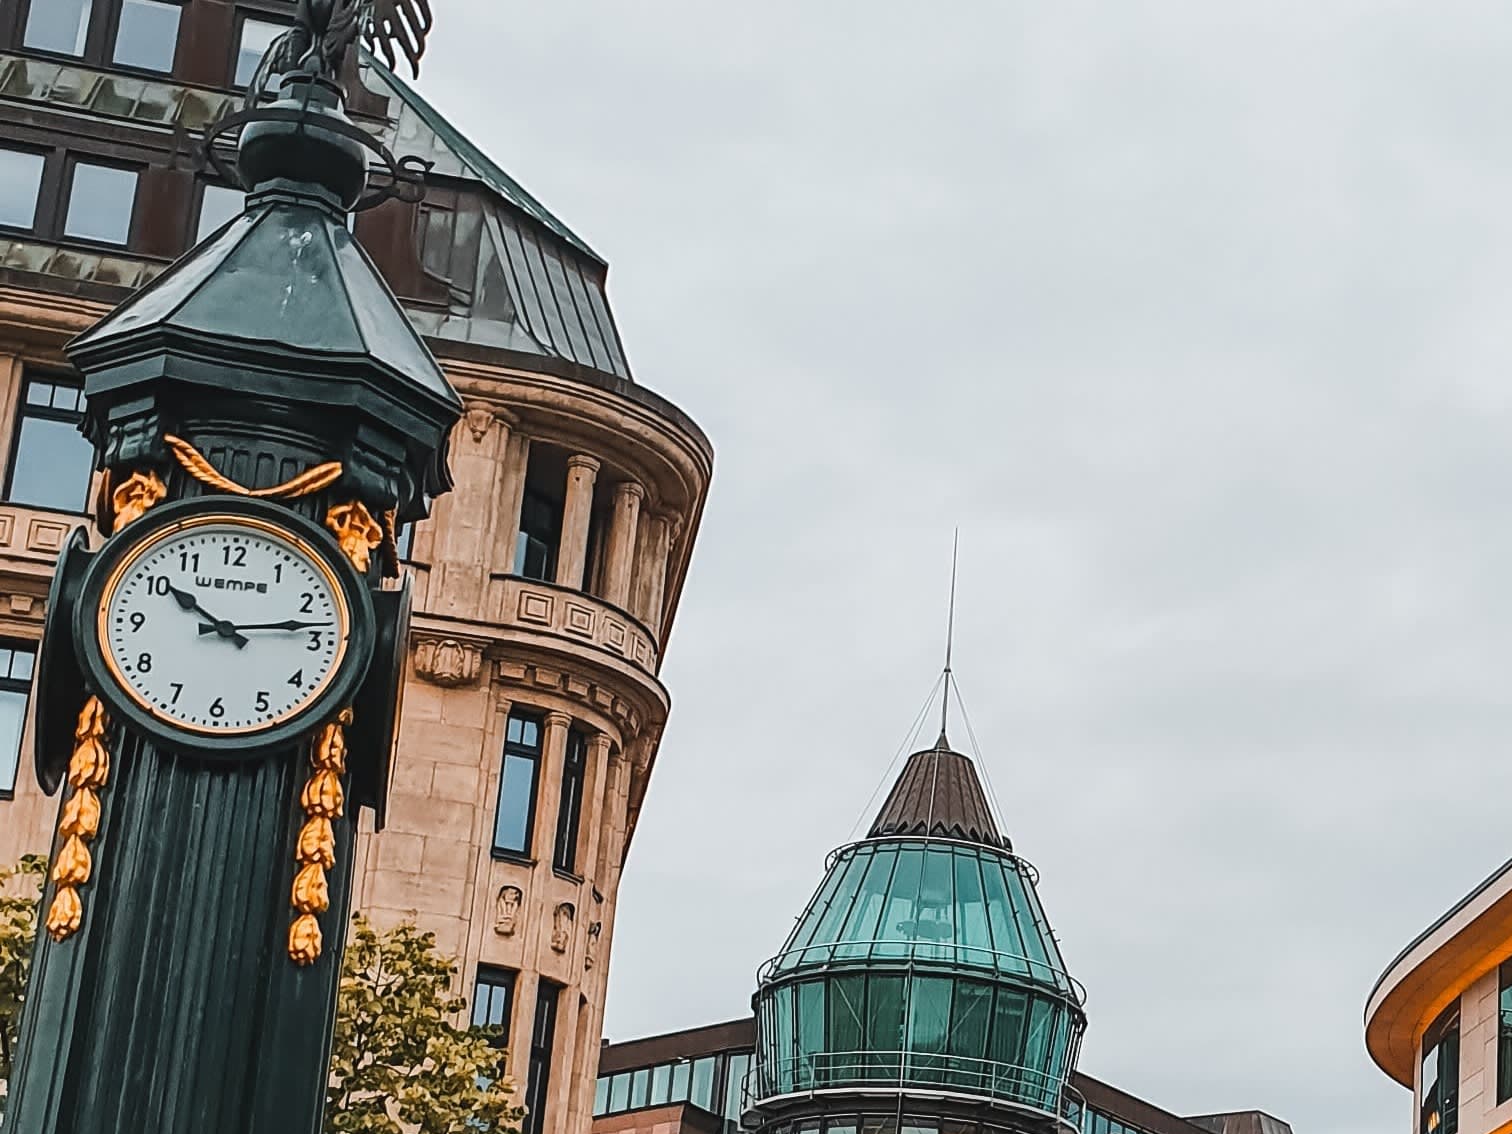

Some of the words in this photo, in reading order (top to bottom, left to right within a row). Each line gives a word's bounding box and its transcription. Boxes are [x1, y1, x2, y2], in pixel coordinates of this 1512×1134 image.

[179, 551, 200, 573] 11
[222, 545, 247, 567] 12
[273, 563, 283, 583] 1
[147, 575, 170, 596] 10
[195, 575, 267, 594] WEMPE
[299, 592, 314, 613] 2
[129, 612, 146, 633] 9
[306, 631, 322, 651] 3
[136, 653, 152, 673] 8
[287, 669, 303, 688] 4
[169, 683, 184, 704] 7
[255, 691, 270, 712] 5
[209, 697, 225, 717] 6
